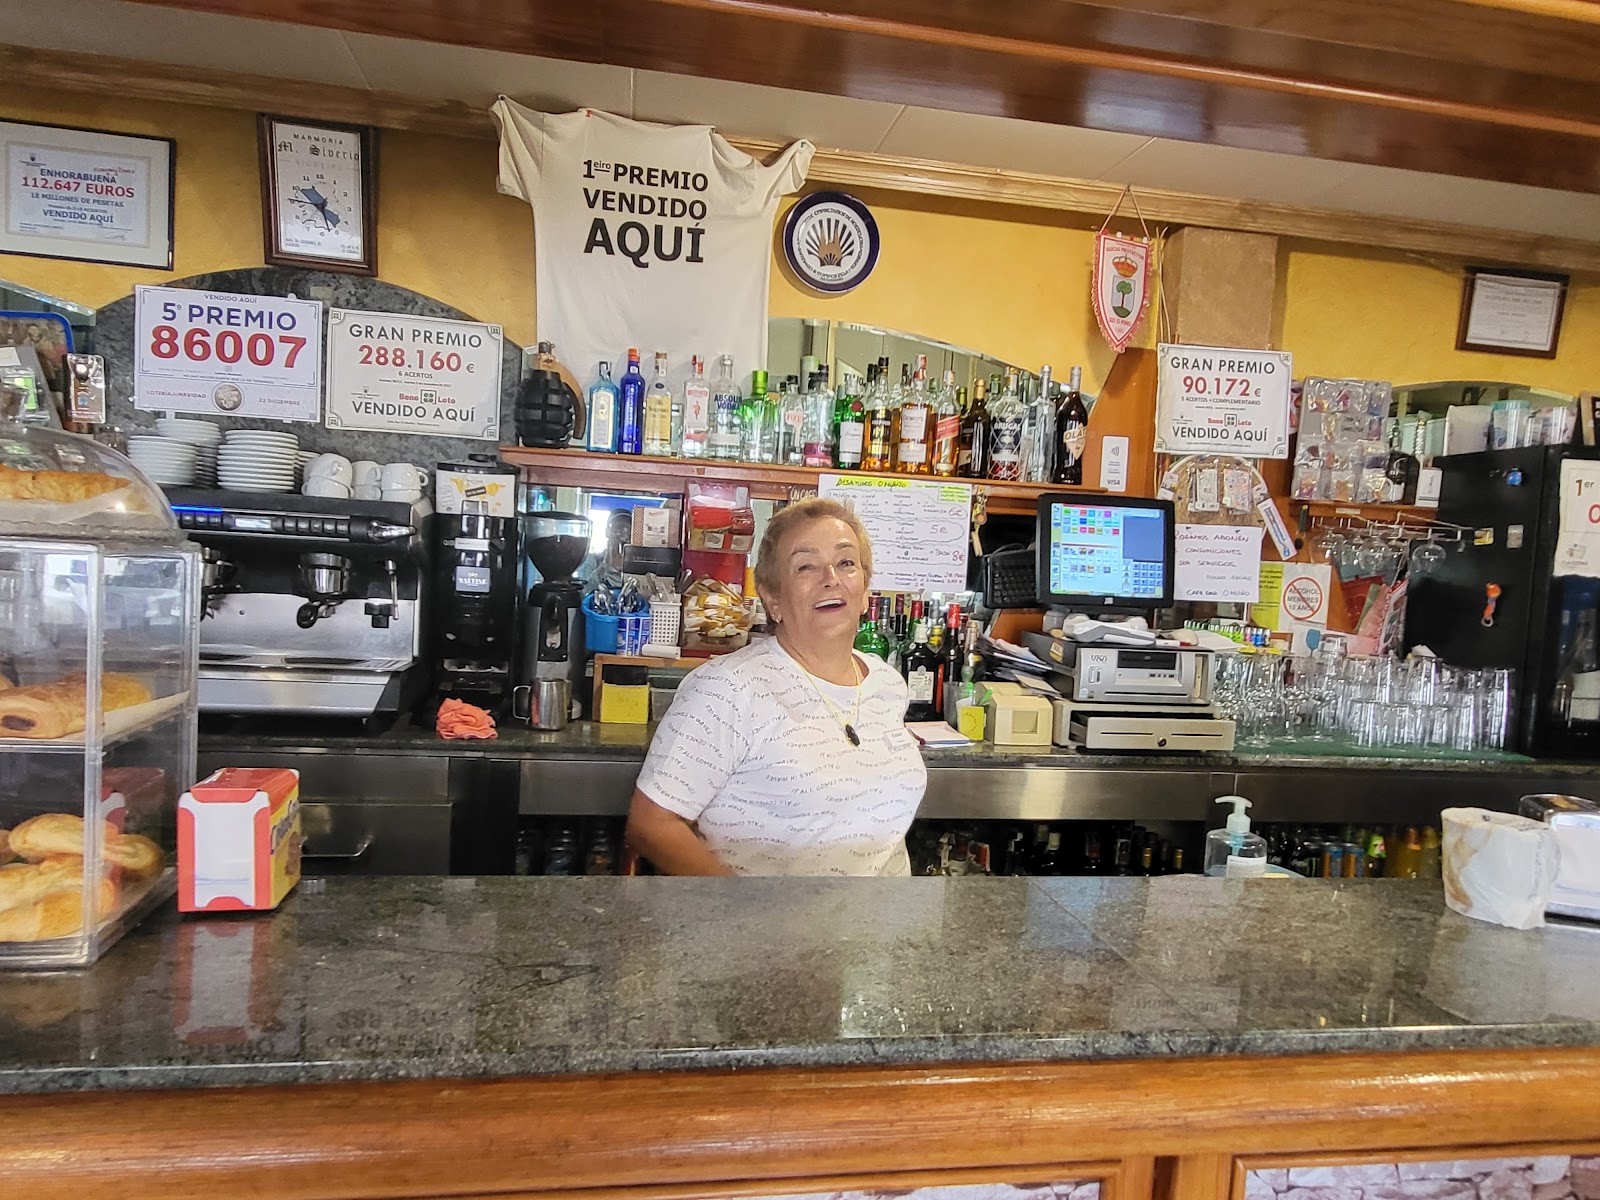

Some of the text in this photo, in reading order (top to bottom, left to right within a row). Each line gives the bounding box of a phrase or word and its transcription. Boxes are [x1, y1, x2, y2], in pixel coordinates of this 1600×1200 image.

[293, 133, 343, 145] MARMORIA
[40, 168, 116, 184] ENHORABUENA
[613, 163, 708, 192] PREMIO
[22, 177, 135, 198] 112.647 EUROS
[41, 193, 79, 203] MILLONES
[92, 199, 124, 207] PESETAS
[583, 187, 707, 220] VENDIDO
[42, 209, 87, 220] VENDIDO
[89, 213, 114, 223] AQUÍ
[583, 217, 705, 268] AQUÍ
[204, 293, 257, 304] VENDIDO AQUÍ
[188, 304, 296, 331] PREMIO
[349, 324, 482, 348] GRAN PREMIO
[151, 325, 307, 369] 86007
[358, 344, 475, 373] 288.160 €
[1170, 356, 1275, 374] GRAN PREMIO
[1183, 375, 1262, 398] 90.172 €
[399, 393, 456, 404] Bono Loto
[352, 401, 475, 422] VENDIDO AQUÍ
[1172, 426, 1268, 442] VENDIDO AQUÍ
